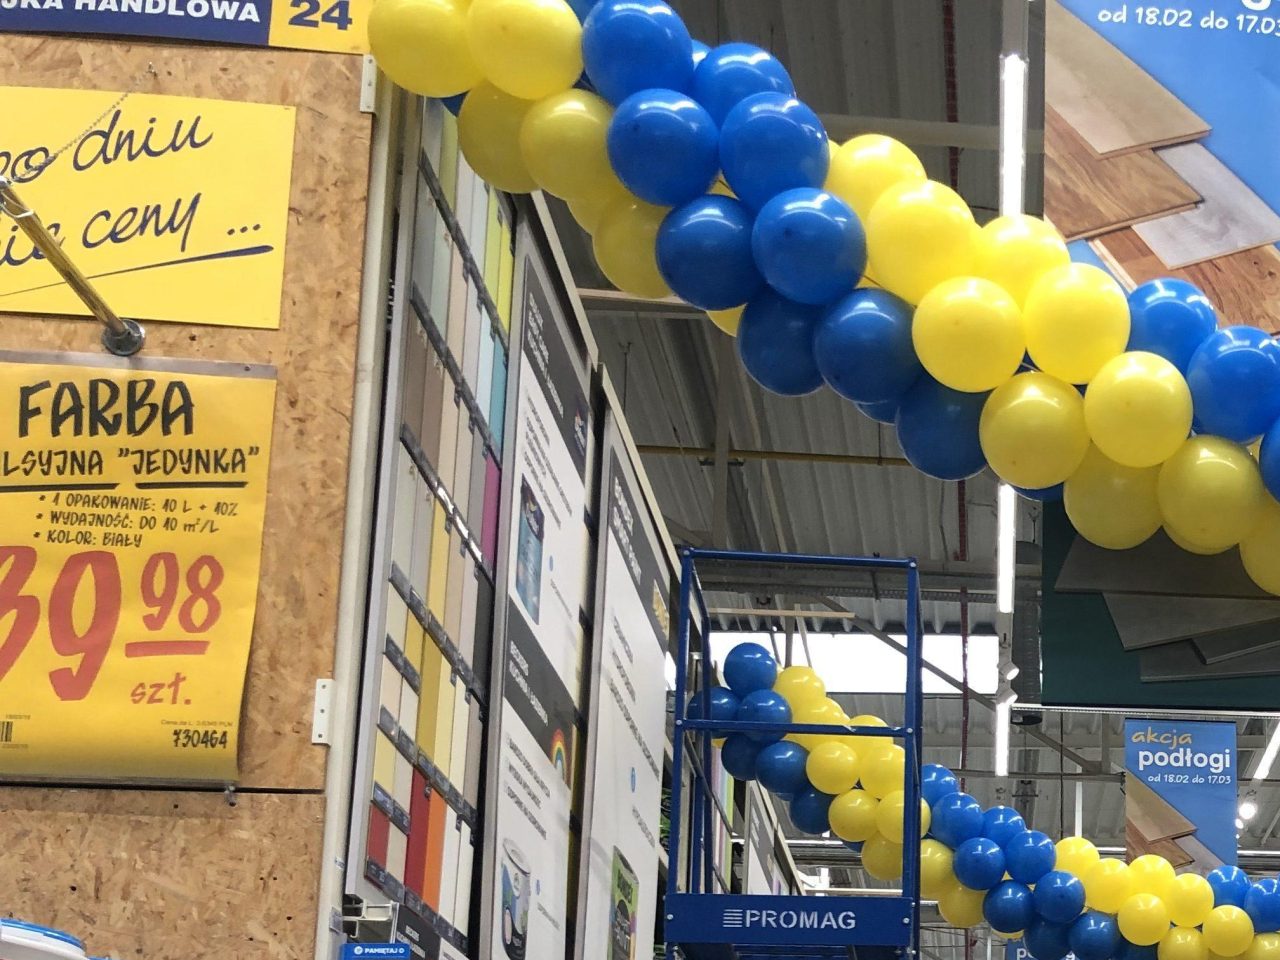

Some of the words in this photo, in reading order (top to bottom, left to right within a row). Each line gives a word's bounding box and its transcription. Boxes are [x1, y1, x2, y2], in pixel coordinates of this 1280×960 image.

[288, 0, 353, 31] 24
[1098, 4, 1127, 24] od
[1135, 7, 1193, 28] 18.02
[1200, 10, 1229, 30] do
[73, 109, 213, 171] dniu
[82, 193, 202, 252] ceny
[18, 378, 195, 438] FARBA
[139, 516, 157, 530] DO
[47, 530, 97, 546] KOLOR:
[103, 532, 142, 548] BIAŁY
[140, 551, 225, 634] 98
[130, 672, 192, 707] szt.
[1131, 726, 1193, 750] akcja
[1138, 747, 1230, 774] podłogi
[1148, 773, 1160, 782] od
[1163, 774, 1189, 783] 18.02
[1191, 774, 1205, 784] do
[1207, 775, 1231, 784] 17.03
[745, 909, 856, 929] PROMAG
